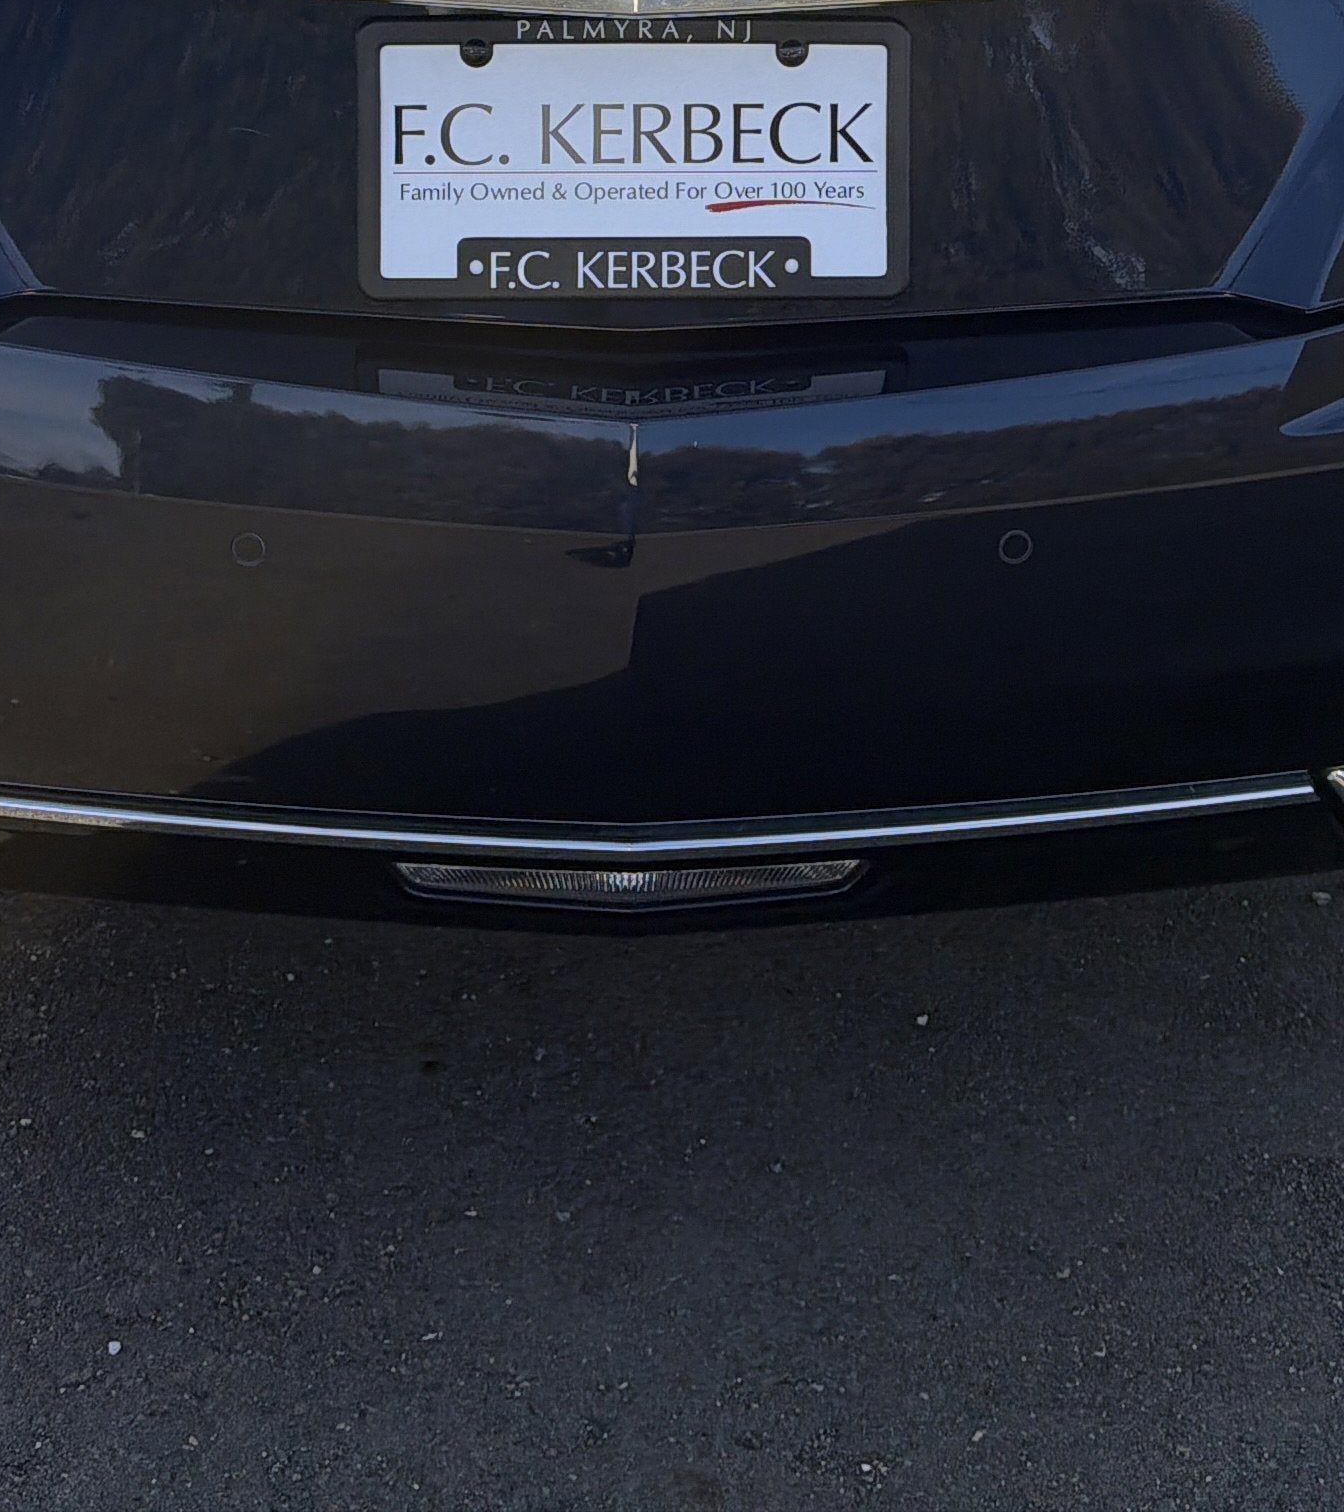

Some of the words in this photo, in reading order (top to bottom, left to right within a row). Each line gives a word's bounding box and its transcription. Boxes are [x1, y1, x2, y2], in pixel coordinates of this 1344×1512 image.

[516, 20, 693, 43] PALMYRA,
[717, 20, 752, 43] NJ
[394, 103, 510, 166] F.C.
[541, 102, 874, 165] KERBECK
[399, 181, 464, 206] Family
[470, 181, 545, 202] Owned
[552, 182, 568, 201] &
[574, 180, 669, 205] Operated
[675, 181, 707, 200] For
[714, 180, 763, 200] Over
[771, 181, 806, 200] 100
[813, 180, 865, 200] Years
[490, 250, 560, 290] F.C.
[577, 250, 777, 290] KERBECK
